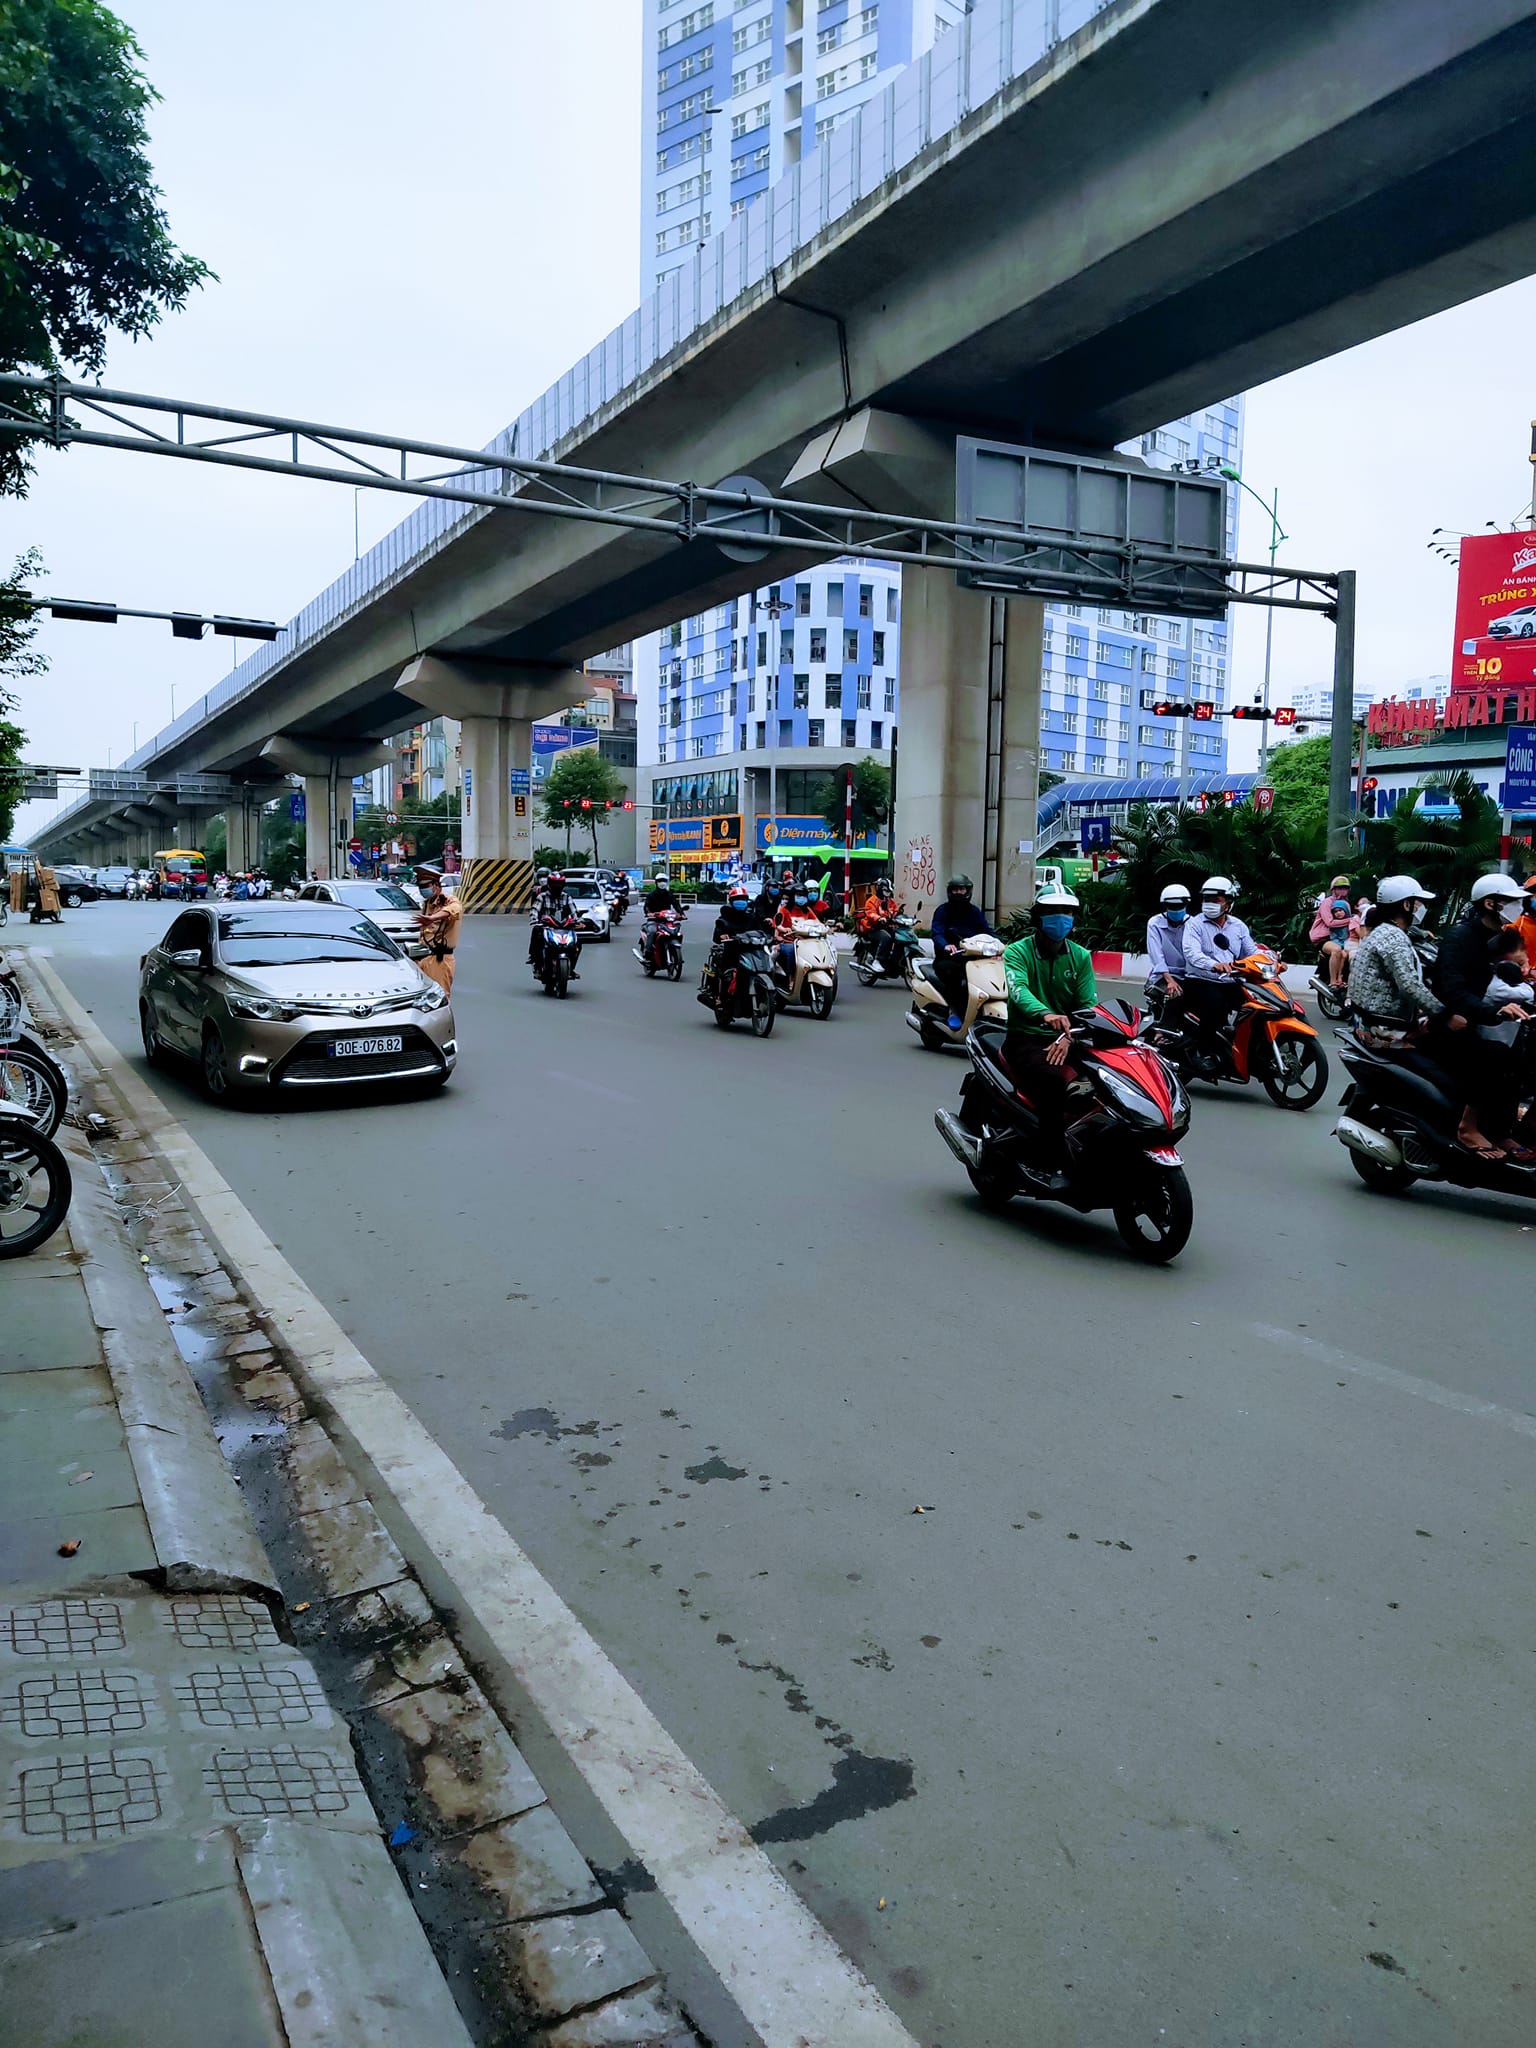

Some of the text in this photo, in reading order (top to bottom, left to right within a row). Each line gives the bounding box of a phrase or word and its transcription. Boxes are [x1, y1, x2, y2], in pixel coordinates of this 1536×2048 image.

[1479, 588, 1528, 606] TRÚNG
[1476, 657, 1502, 675] 10
[1197, 705, 1211, 718] 24
[1277, 710, 1292, 723] 24
[1367, 694, 1437, 734] KÍNH
[780, 827, 804, 840] Điện
[336, 1038, 401, 1056] 30E-076.82
